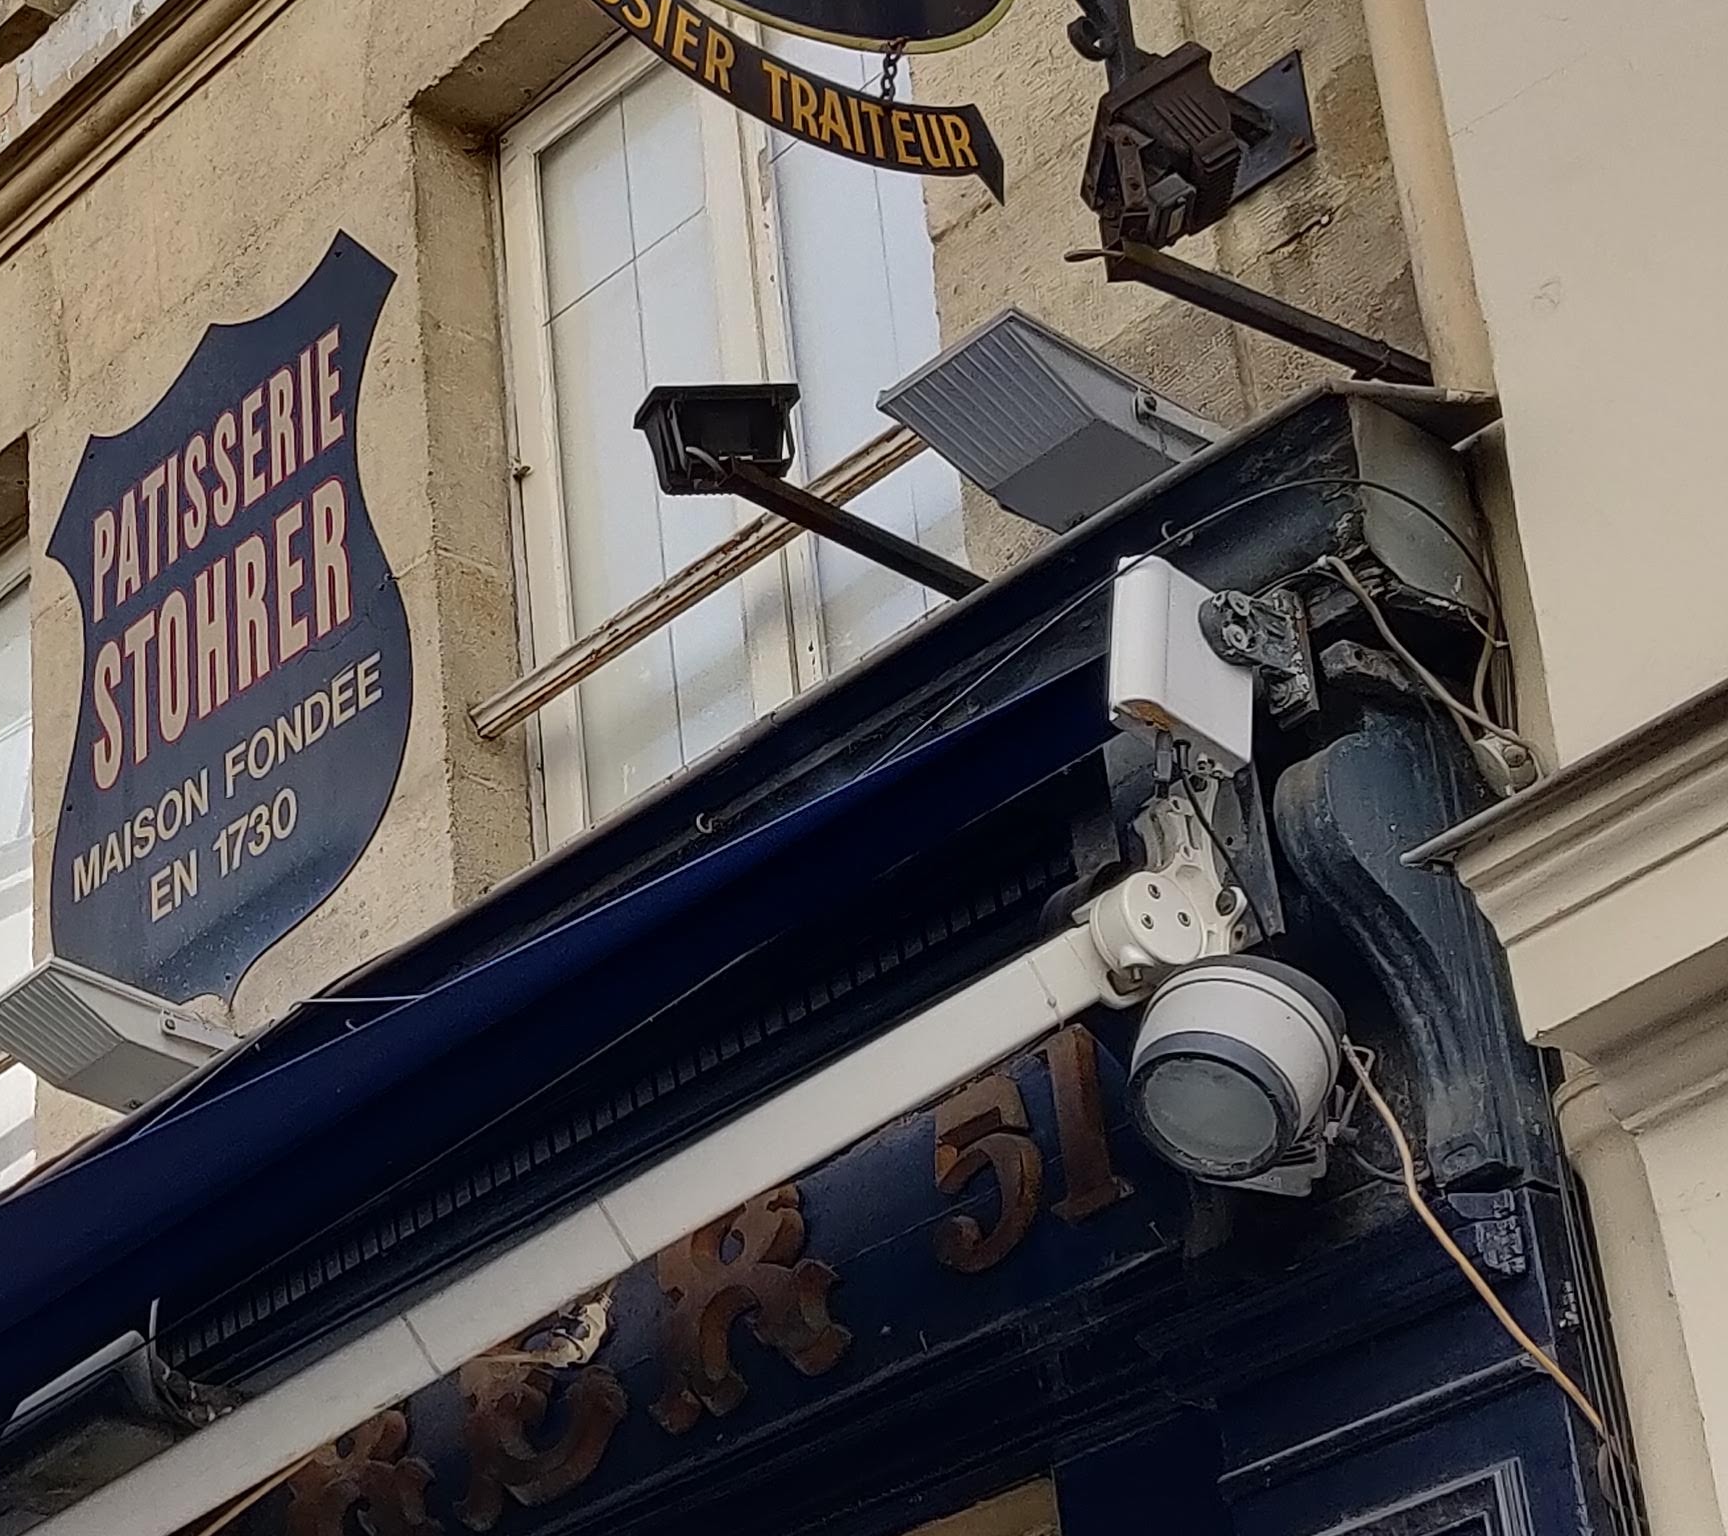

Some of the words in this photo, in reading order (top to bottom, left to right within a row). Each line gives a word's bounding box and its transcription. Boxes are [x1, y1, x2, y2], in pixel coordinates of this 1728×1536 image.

[762, 60, 978, 168] TRAITEUR
[92, 324, 345, 624] PATISSERIE
[92, 476, 353, 791] STOHRER
[73, 767, 209, 903] MAISON
[224, 651, 383, 799] FONDÉE
[150, 849, 199, 923] EN
[212, 786, 298, 878] 1730
[934, 1024, 1136, 1274] 51
